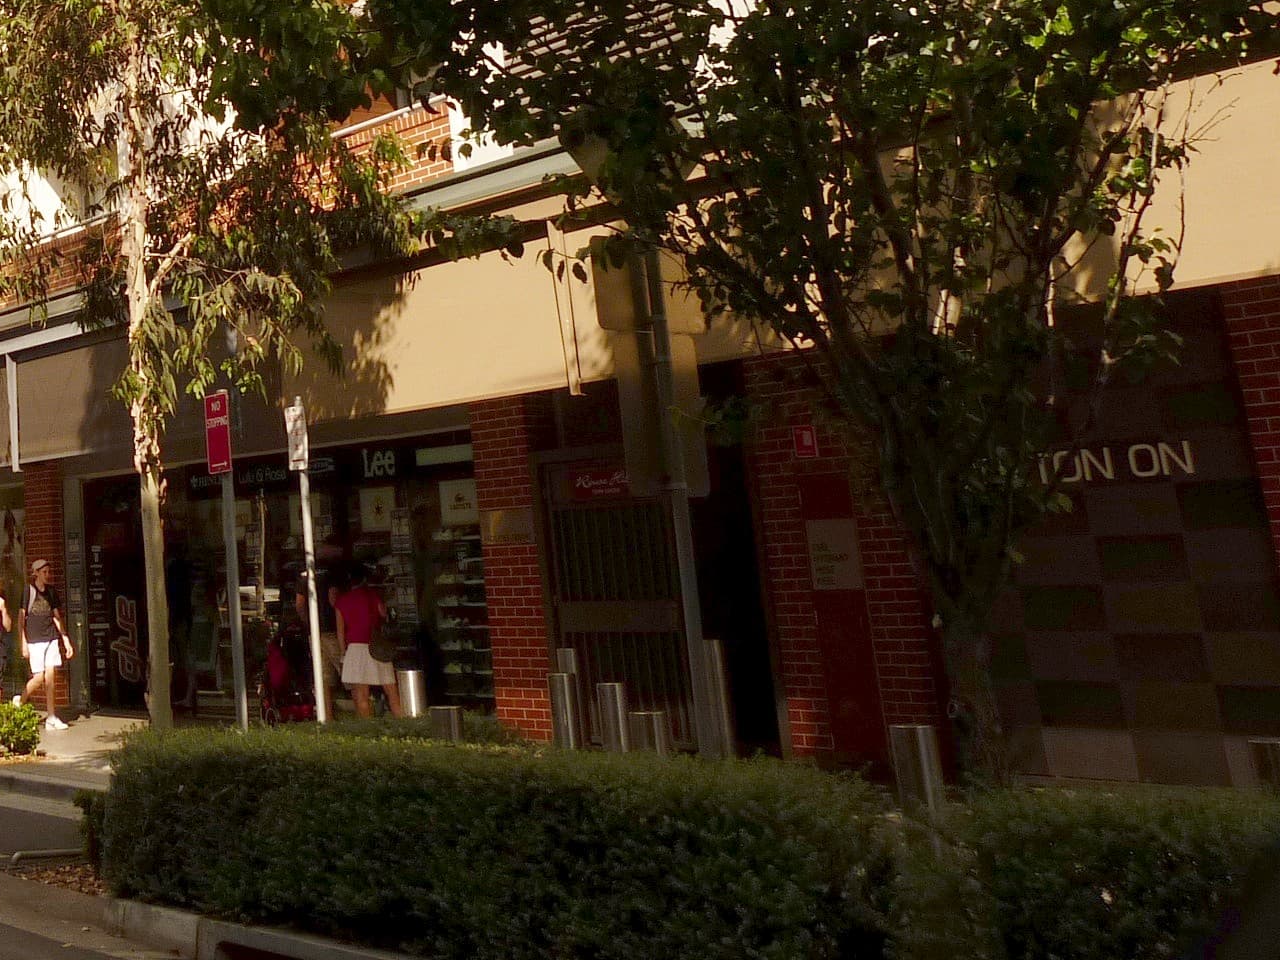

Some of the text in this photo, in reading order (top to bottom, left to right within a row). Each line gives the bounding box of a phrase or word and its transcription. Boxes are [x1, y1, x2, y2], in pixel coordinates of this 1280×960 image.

[210, 400, 221, 412] NO
[362, 449, 396, 479] Lee
[1127, 440, 1196, 477] ON
